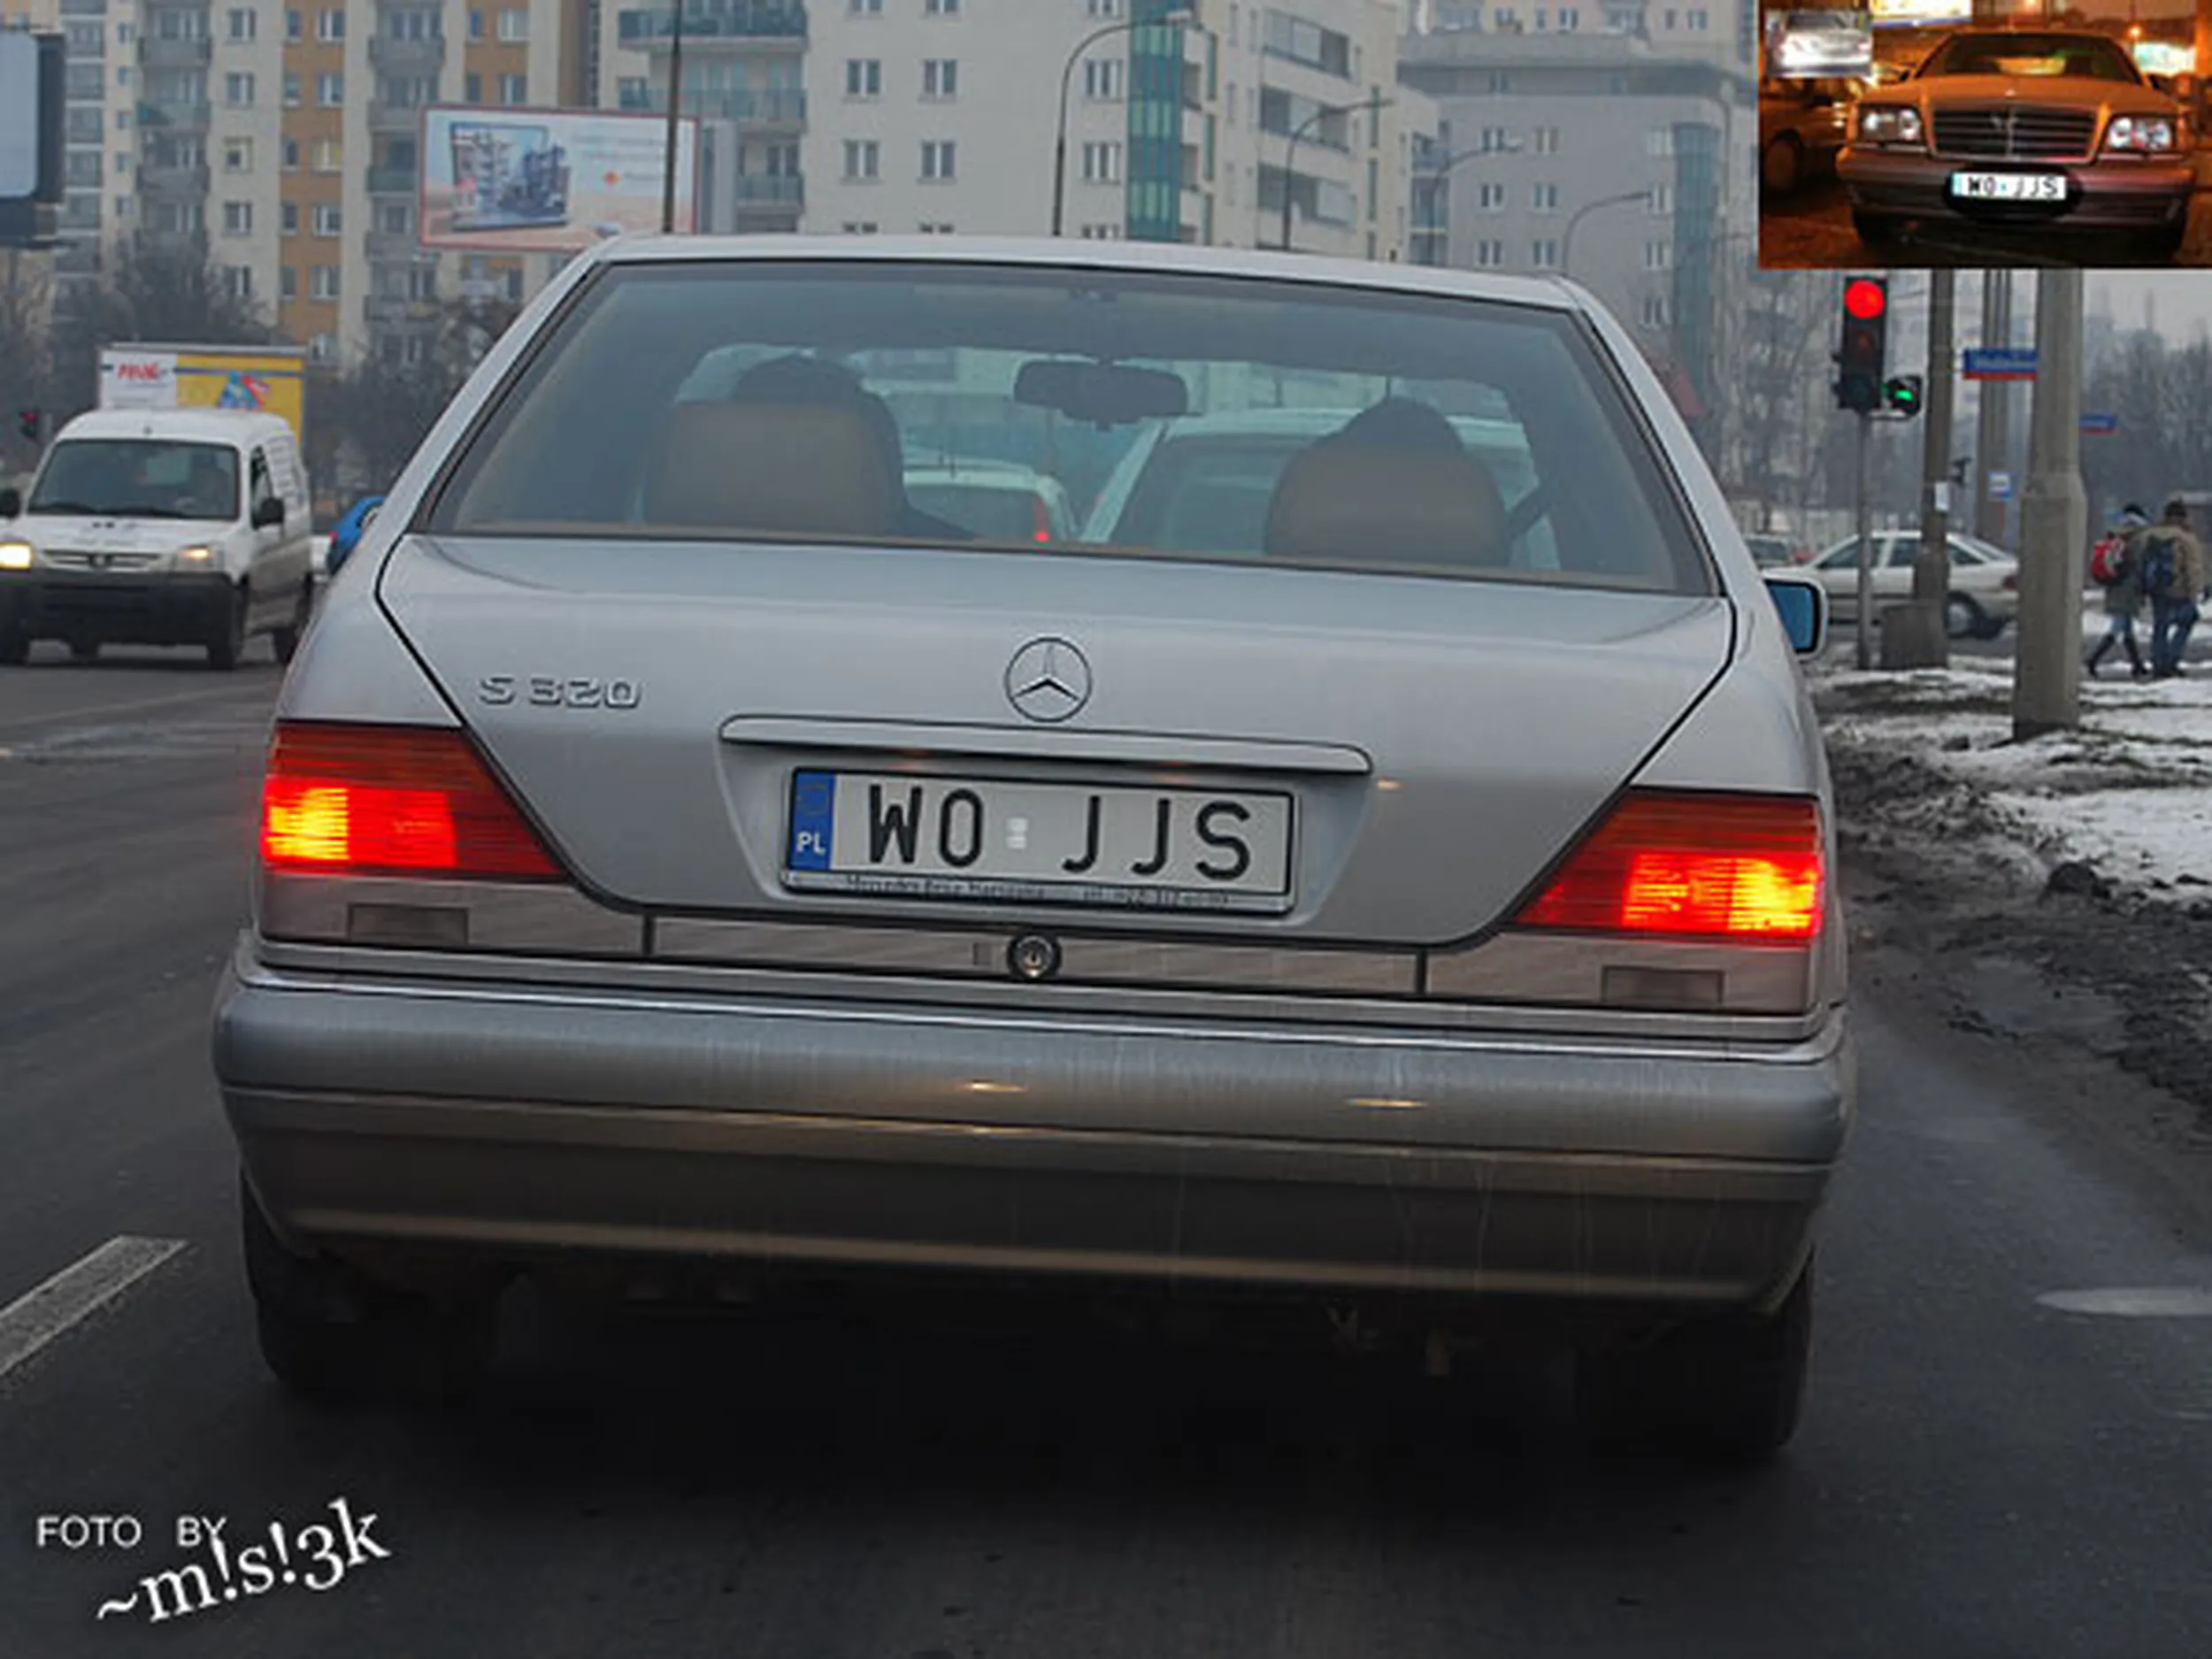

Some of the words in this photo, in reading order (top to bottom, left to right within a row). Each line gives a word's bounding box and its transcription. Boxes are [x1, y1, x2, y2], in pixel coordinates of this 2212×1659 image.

[478, 674, 516, 706] S
[528, 676, 641, 710] 320
[795, 832, 826, 856] PL
[1062, 795, 1251, 880] JJS
